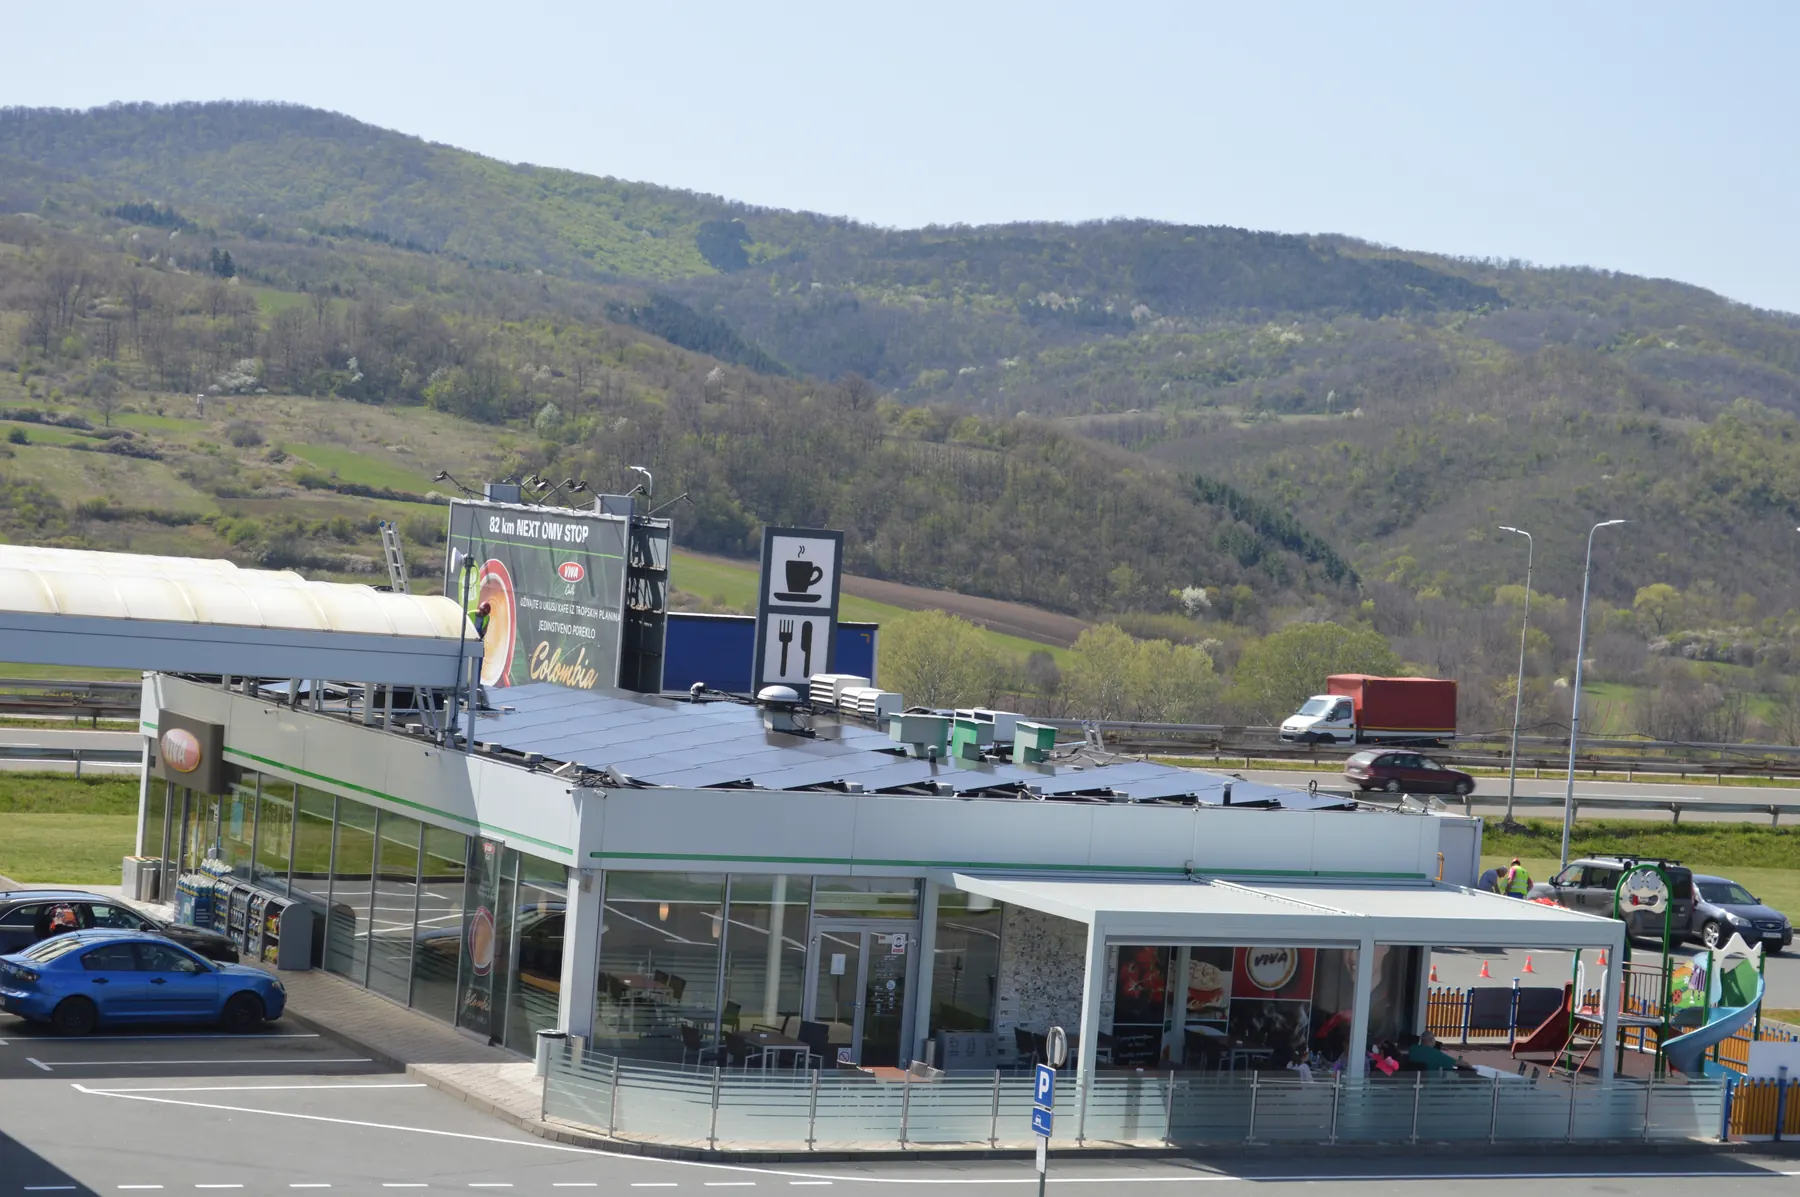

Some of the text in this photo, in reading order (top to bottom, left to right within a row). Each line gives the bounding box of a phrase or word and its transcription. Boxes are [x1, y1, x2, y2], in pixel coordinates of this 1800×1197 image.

[489, 516, 589, 543] 82 km NEXT OMV STOP
[557, 602, 569, 614] KAFE
[569, 604, 575, 615] IZ
[575, 605, 598, 619] TROPSKIH
[538, 619, 596, 639] JEDINSTVENO POREKLO
[531, 641, 598, 689] Colombia
[1254, 951, 1289, 967] VIVA
[1038, 1070, 1050, 1099] P
